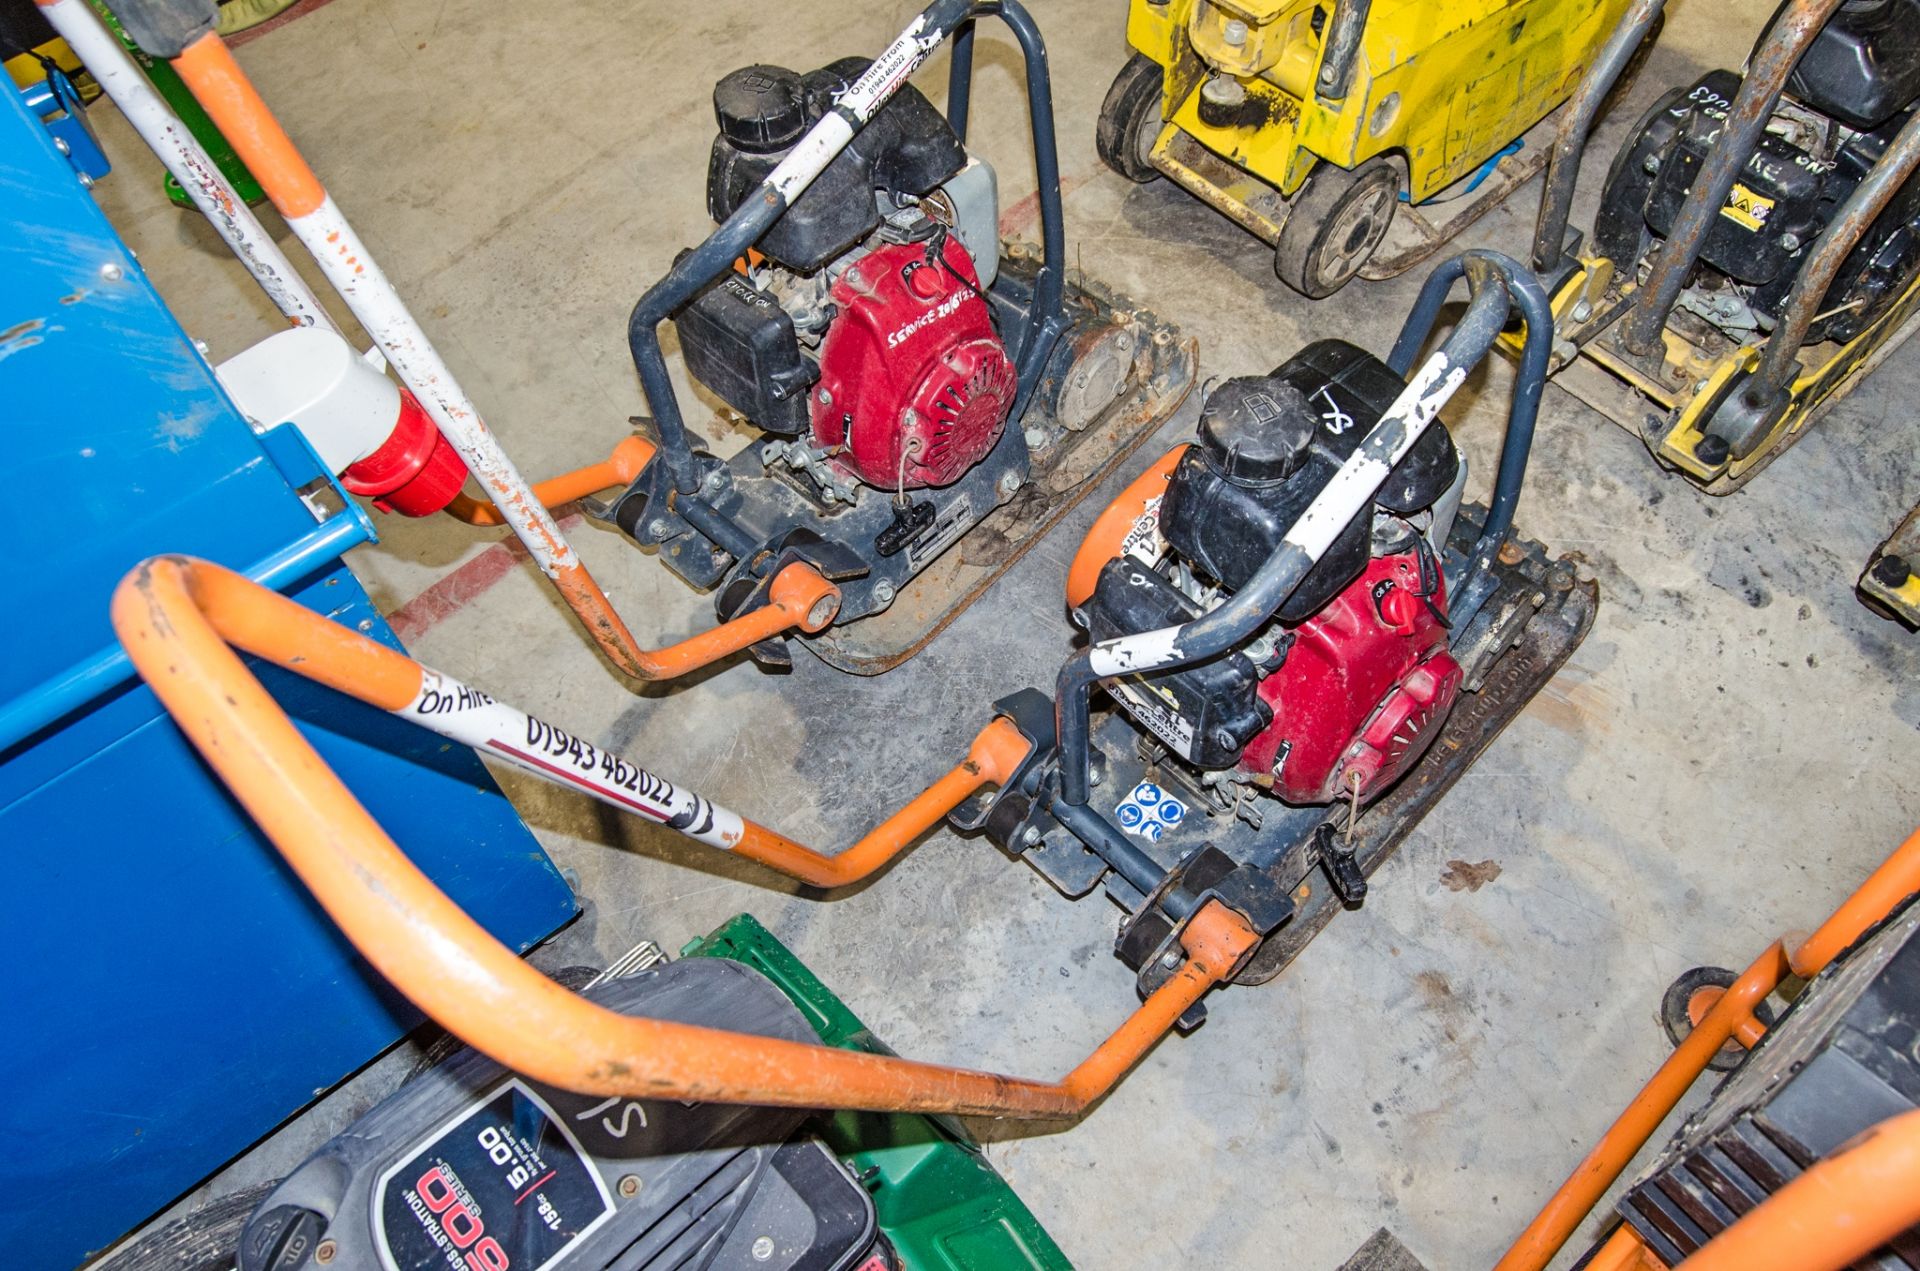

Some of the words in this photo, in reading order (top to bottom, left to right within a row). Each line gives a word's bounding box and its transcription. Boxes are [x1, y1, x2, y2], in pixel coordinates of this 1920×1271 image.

[881, 40, 905, 64] From
[868, 75, 887, 95] 01943
[885, 54, 906, 78] 462022
[417, 690, 453, 714] On
[1137, 709, 1178, 744] 462022
[525, 715, 596, 770] 01943
[601, 751, 675, 807] 462022
[477, 1125, 530, 1191] 5.00
[438, 1161, 482, 1218] SERIES
[416, 1165, 510, 1271] 500
[284, 1235, 308, 1265] OIL
